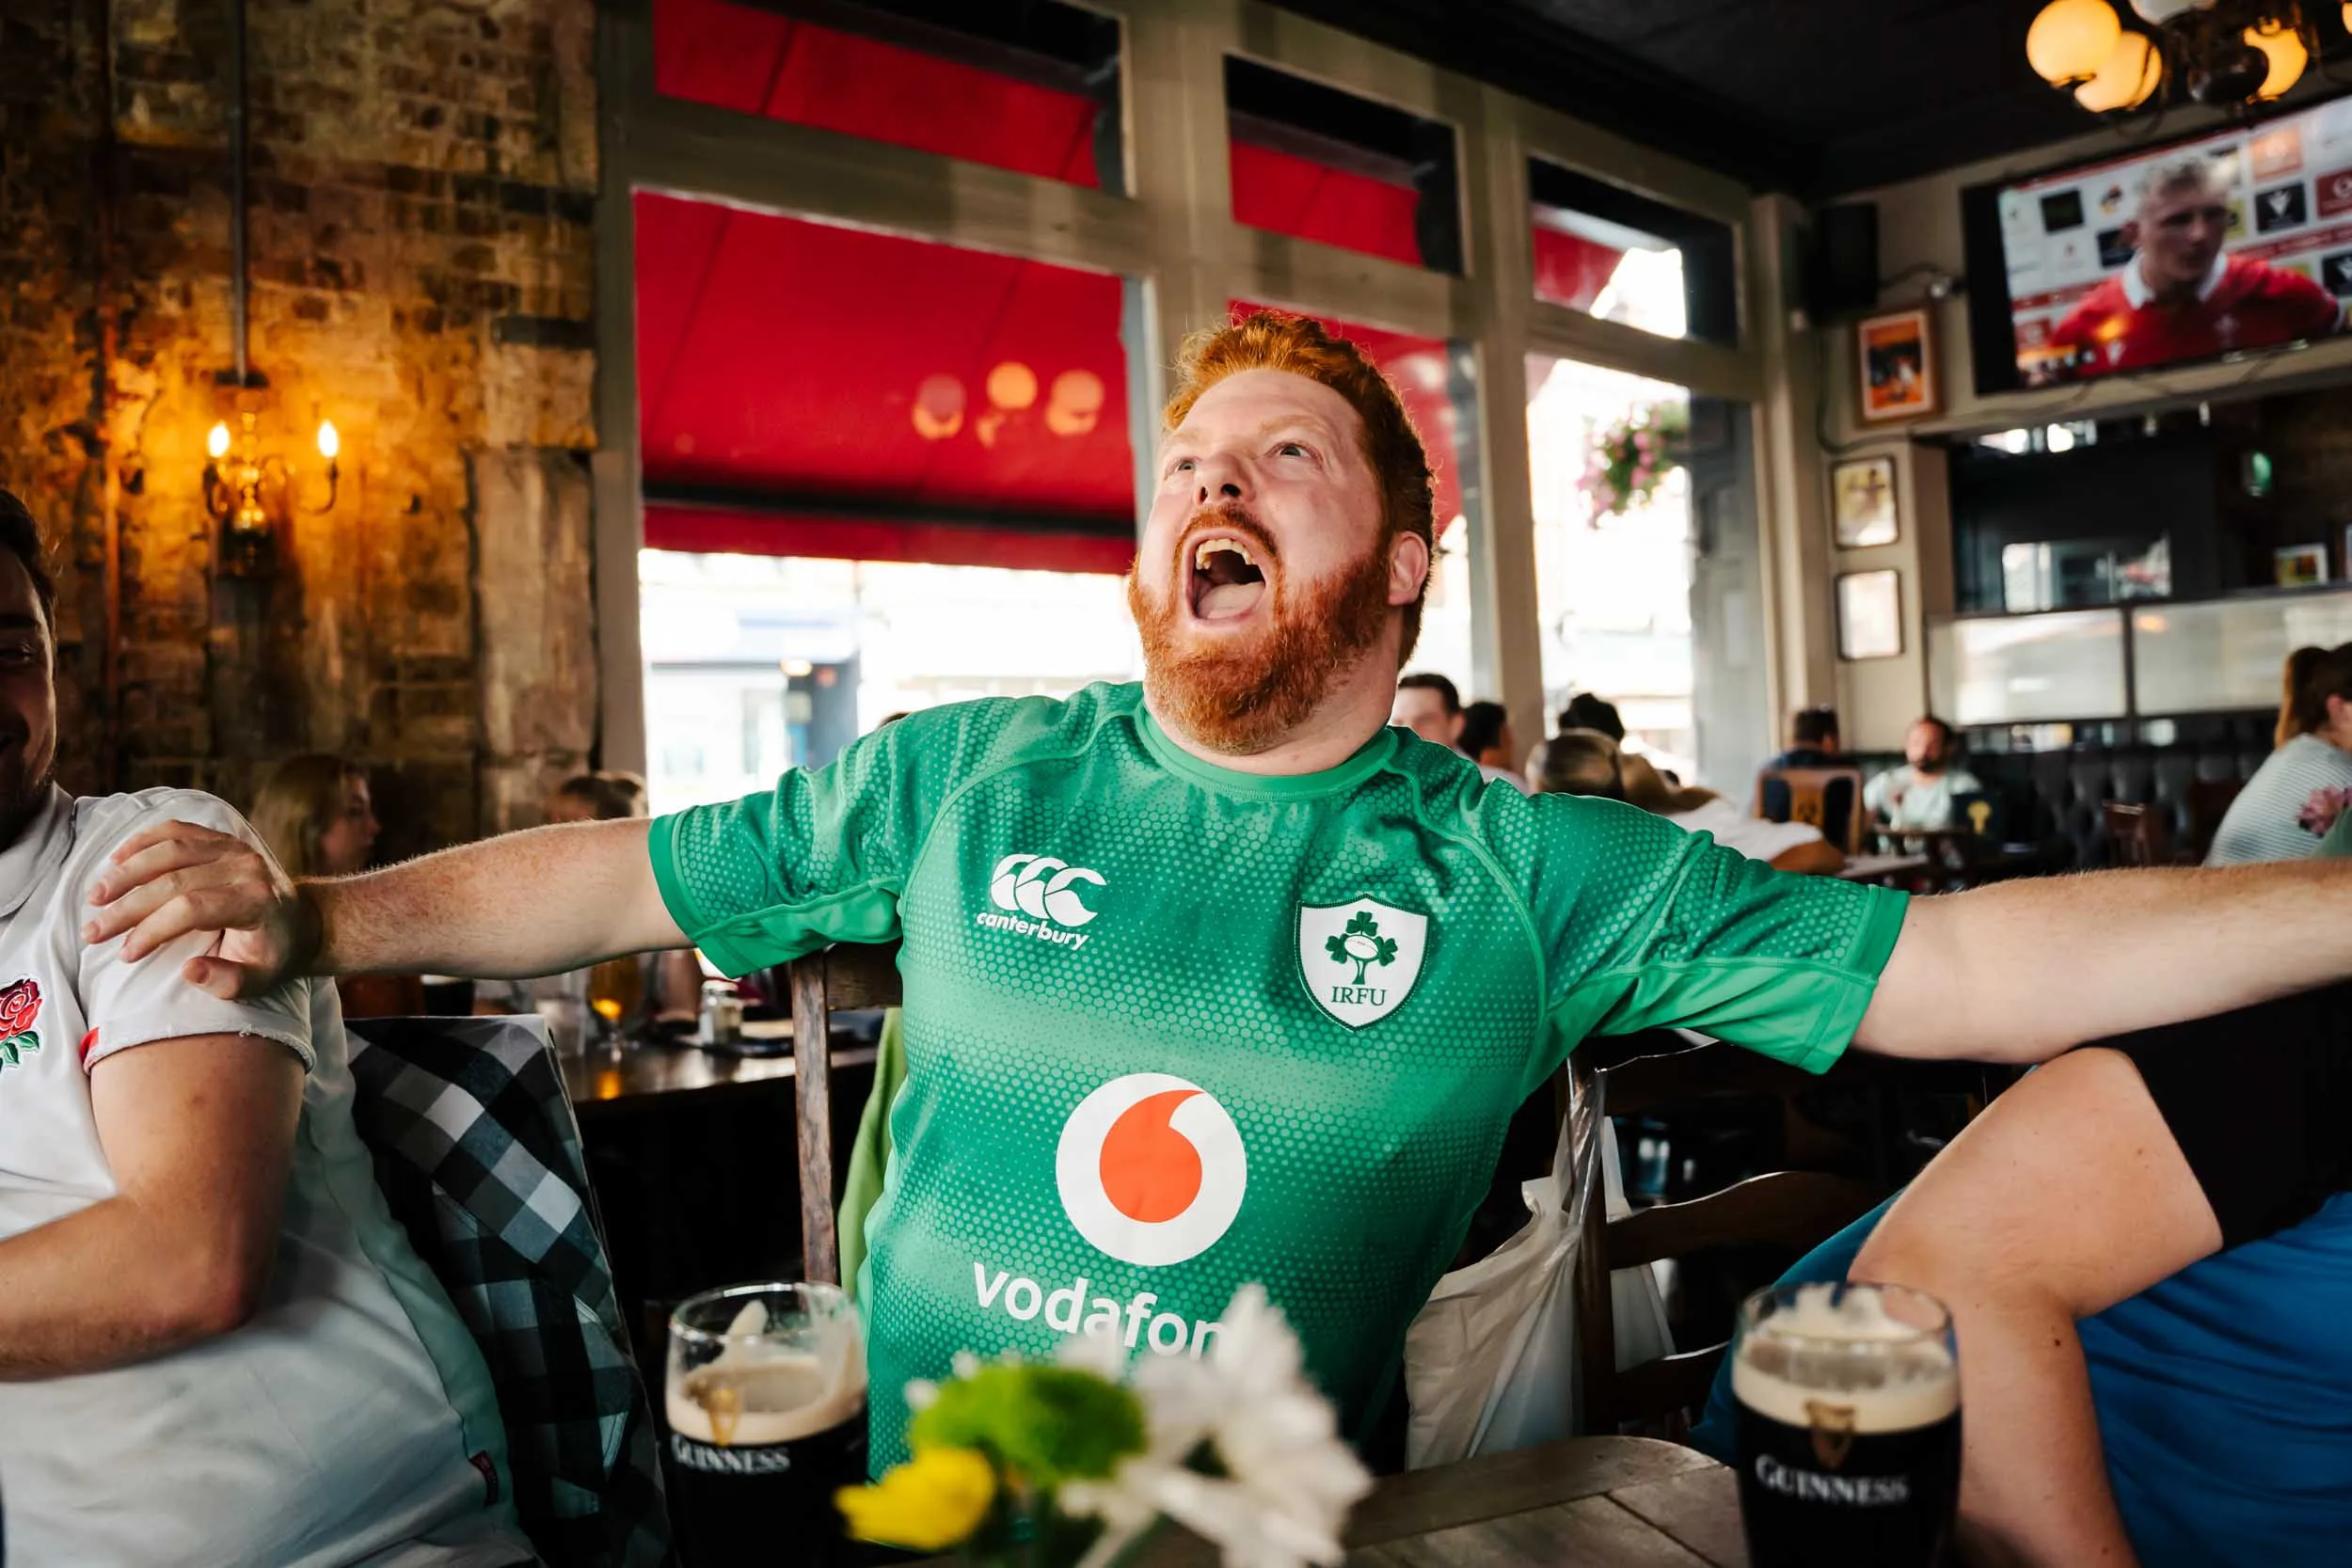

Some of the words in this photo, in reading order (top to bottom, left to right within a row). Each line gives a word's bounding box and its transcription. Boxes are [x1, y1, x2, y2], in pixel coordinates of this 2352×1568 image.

[976, 912, 1089, 951] canterbury
[1330, 986, 1387, 1006] IRFU
[973, 1261, 1227, 1361] vodafon
[671, 1433, 790, 1474] GUINNESS
[1756, 1453, 1910, 1505] GUINNESS
